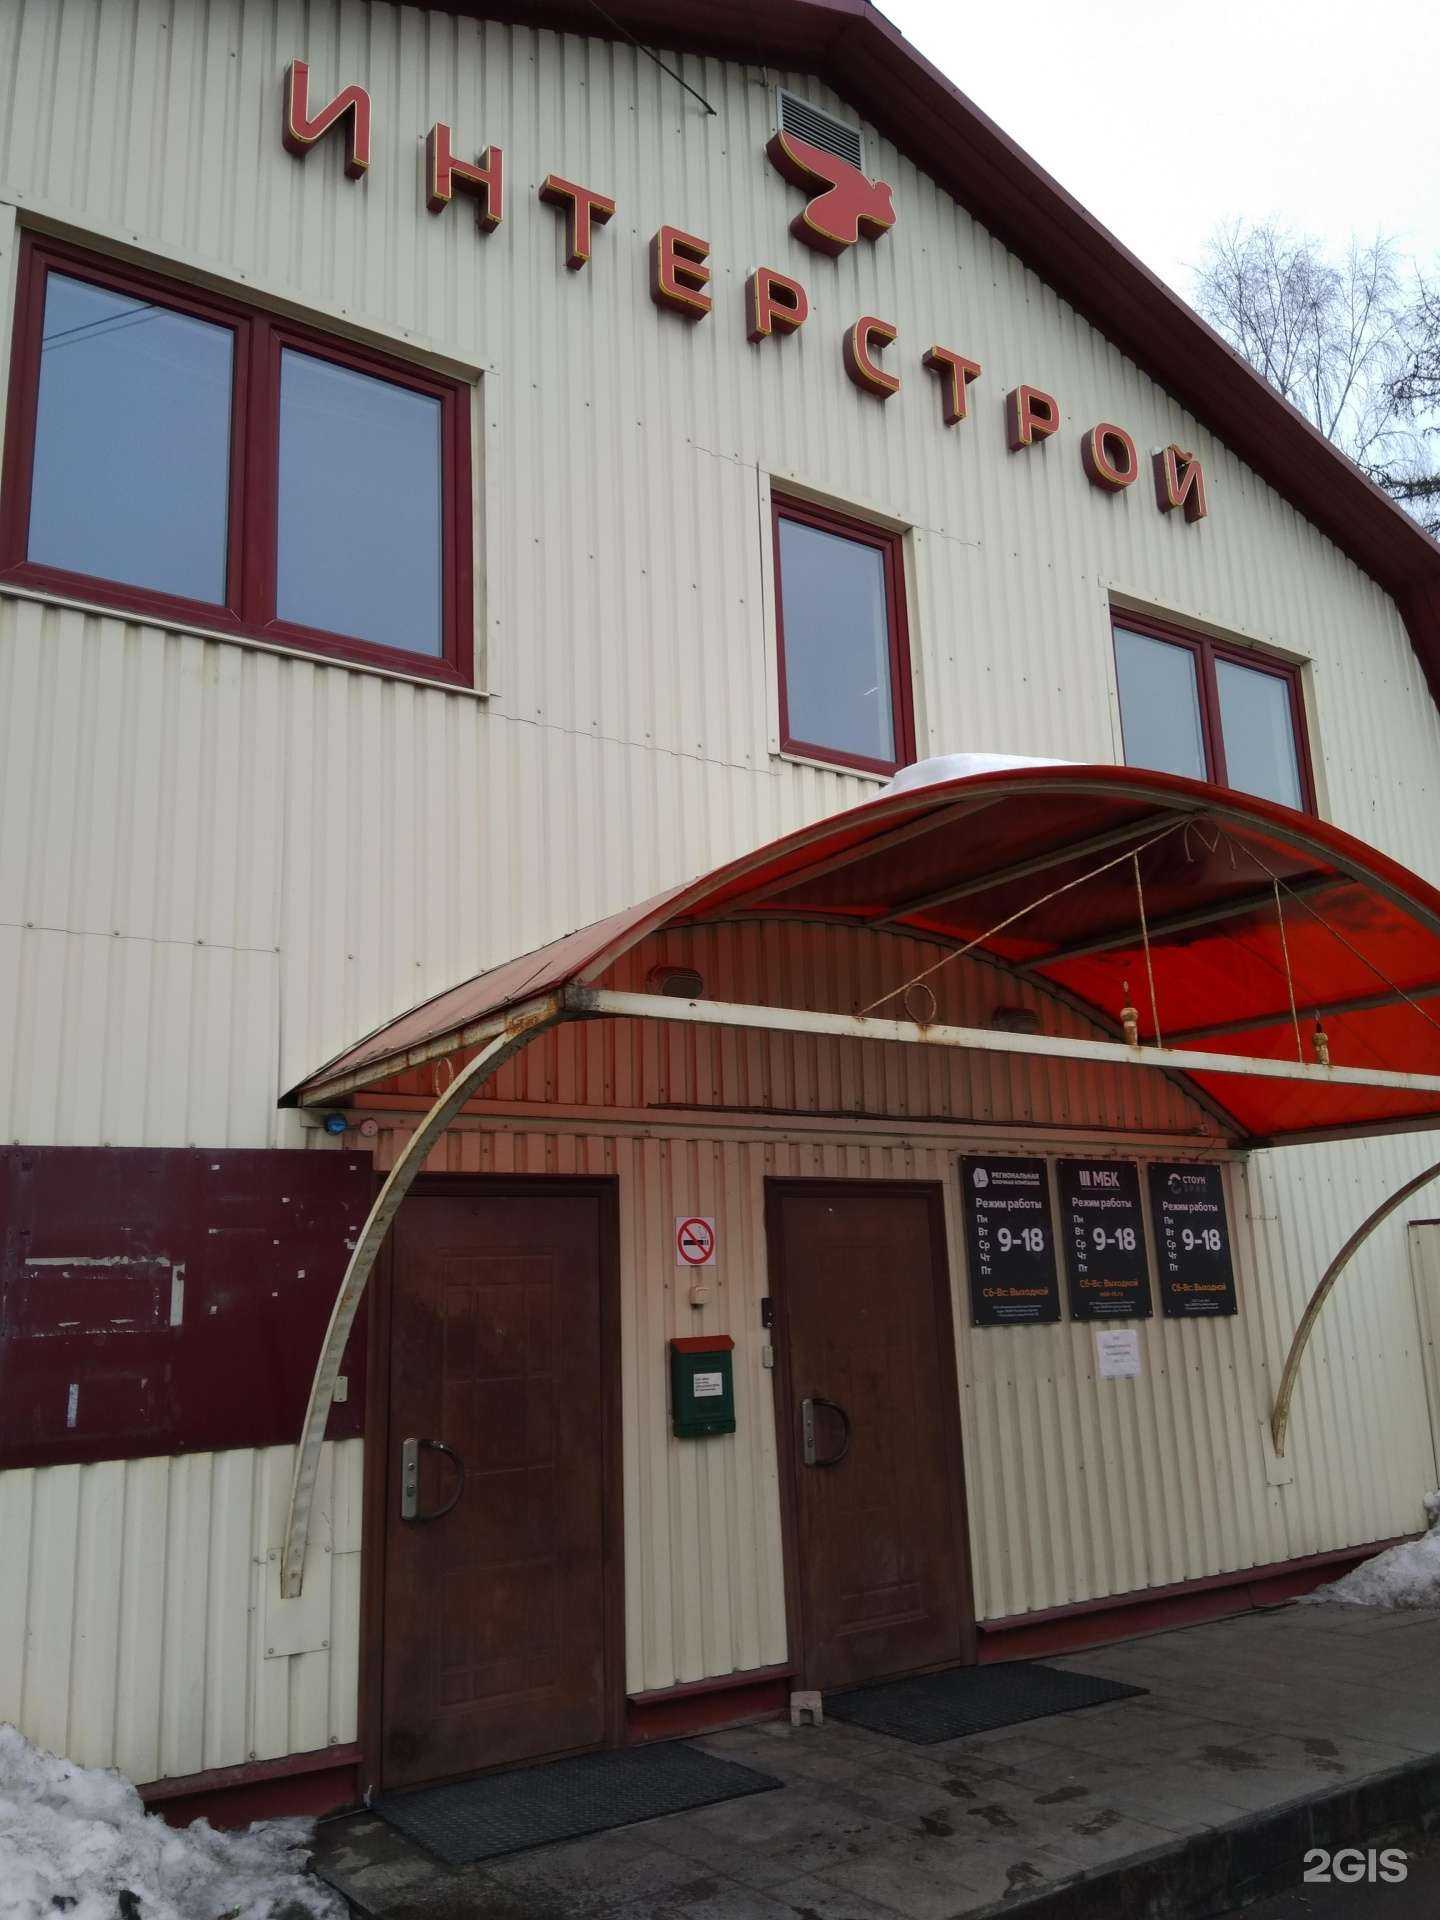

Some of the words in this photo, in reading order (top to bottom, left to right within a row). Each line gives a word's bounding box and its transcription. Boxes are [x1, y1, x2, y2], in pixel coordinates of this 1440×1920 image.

[283, 57, 1207, 524] ИНТЕРСТРОЙ
[1092, 1171, 1120, 1187] МБК
[1182, 1176, 1206, 1184] СТОУН
[975, 1197, 1007, 1209] Режим
[1007, 1198, 1042, 1212] работы
[1071, 1197, 1100, 1208] Режим
[1100, 1197, 1132, 1210] работы
[1162, 1201, 1189, 1211] Режим
[1189, 1202, 1218, 1214] работы
[976, 1214, 988, 1223] Пн
[1073, 1214, 1084, 1223] Пн
[1164, 1216, 1174, 1225] Пн
[978, 1227, 988, 1236] Вт
[1074, 1226, 1085, 1236] Вт
[1165, 1228, 1175, 1236] Вт
[997, 1227, 1045, 1252] 9-18
[1092, 1227, 1136, 1251] 9-18
[1181, 1228, 1221, 1251] 9-18
[979, 1240, 991, 1252] Ср
[1076, 1239, 1087, 1250] Ср
[1166, 1240, 1177, 1251] Ср
[980, 1252, 991, 1262] Чт
[1077, 1251, 1087, 1260] Чт
[1168, 1251, 1177, 1260] Чт
[981, 1266, 992, 1275] Пт
[1079, 1264, 1088, 1273] Пт
[1169, 1263, 1179, 1272] Пт
